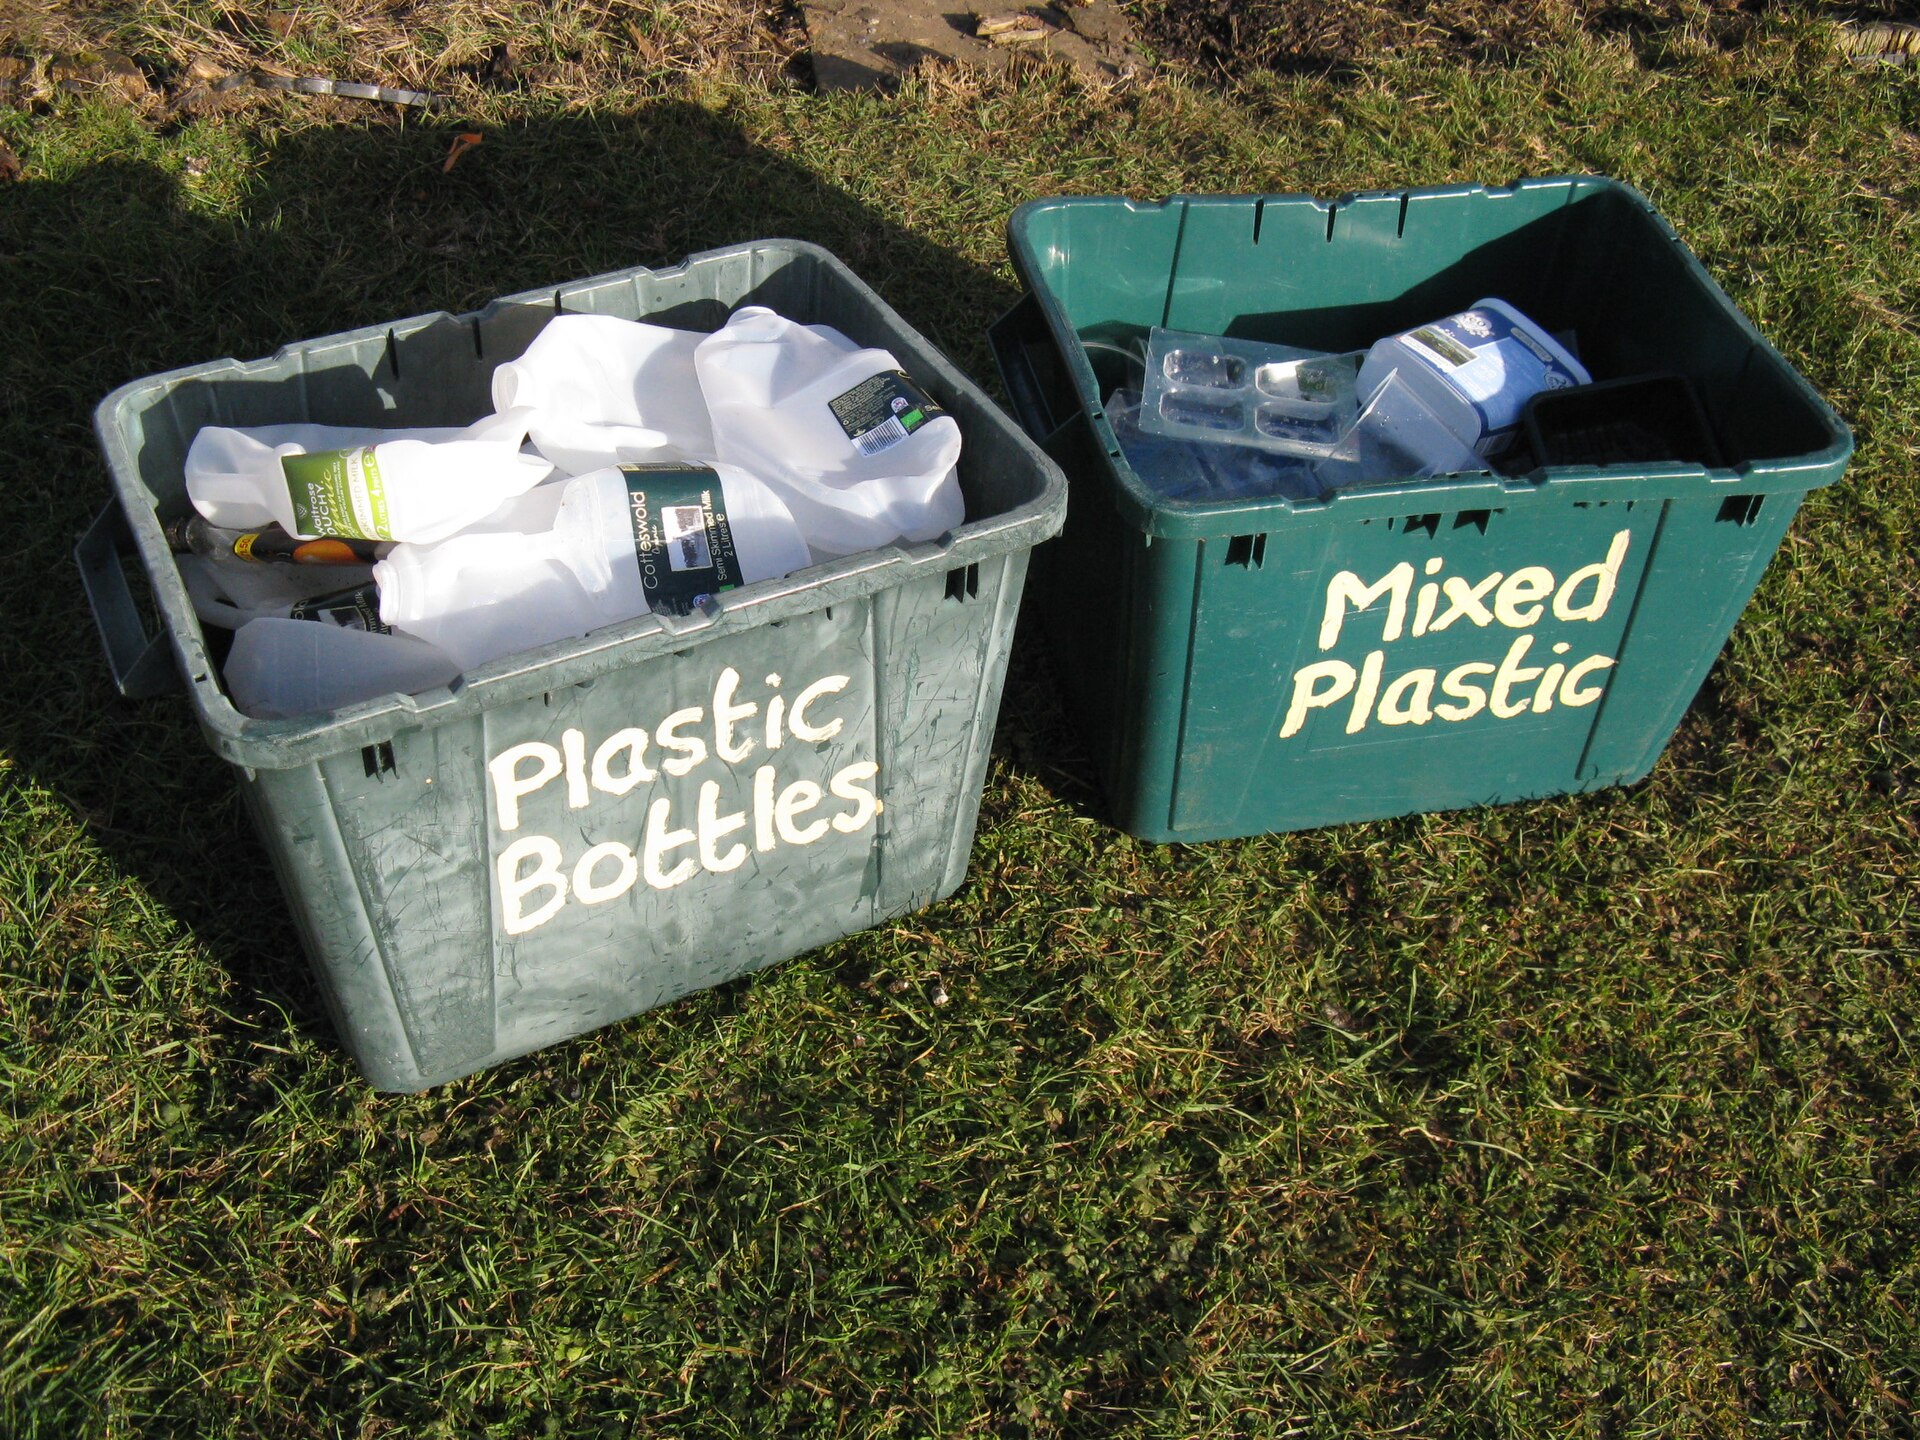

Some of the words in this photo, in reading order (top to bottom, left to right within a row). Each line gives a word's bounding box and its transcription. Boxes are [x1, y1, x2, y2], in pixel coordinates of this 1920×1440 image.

[351, 457, 359, 483] MILK
[370, 489, 381, 497] 4
[307, 482, 327, 537] Waitrose
[314, 483, 338, 536] DUCHY
[701, 490, 712, 510] Milk
[376, 525, 389, 533] 2
[630, 491, 658, 590] Cotteswold
[705, 512, 721, 556] Skimmed
[718, 523, 732, 549] Litres
[716, 557, 728, 581] Semi
[1318, 529, 1631, 652] Mixed
[1279, 634, 1619, 738] Plastic
[489, 667, 851, 831] Plastic
[497, 761, 882, 935] Bottles
